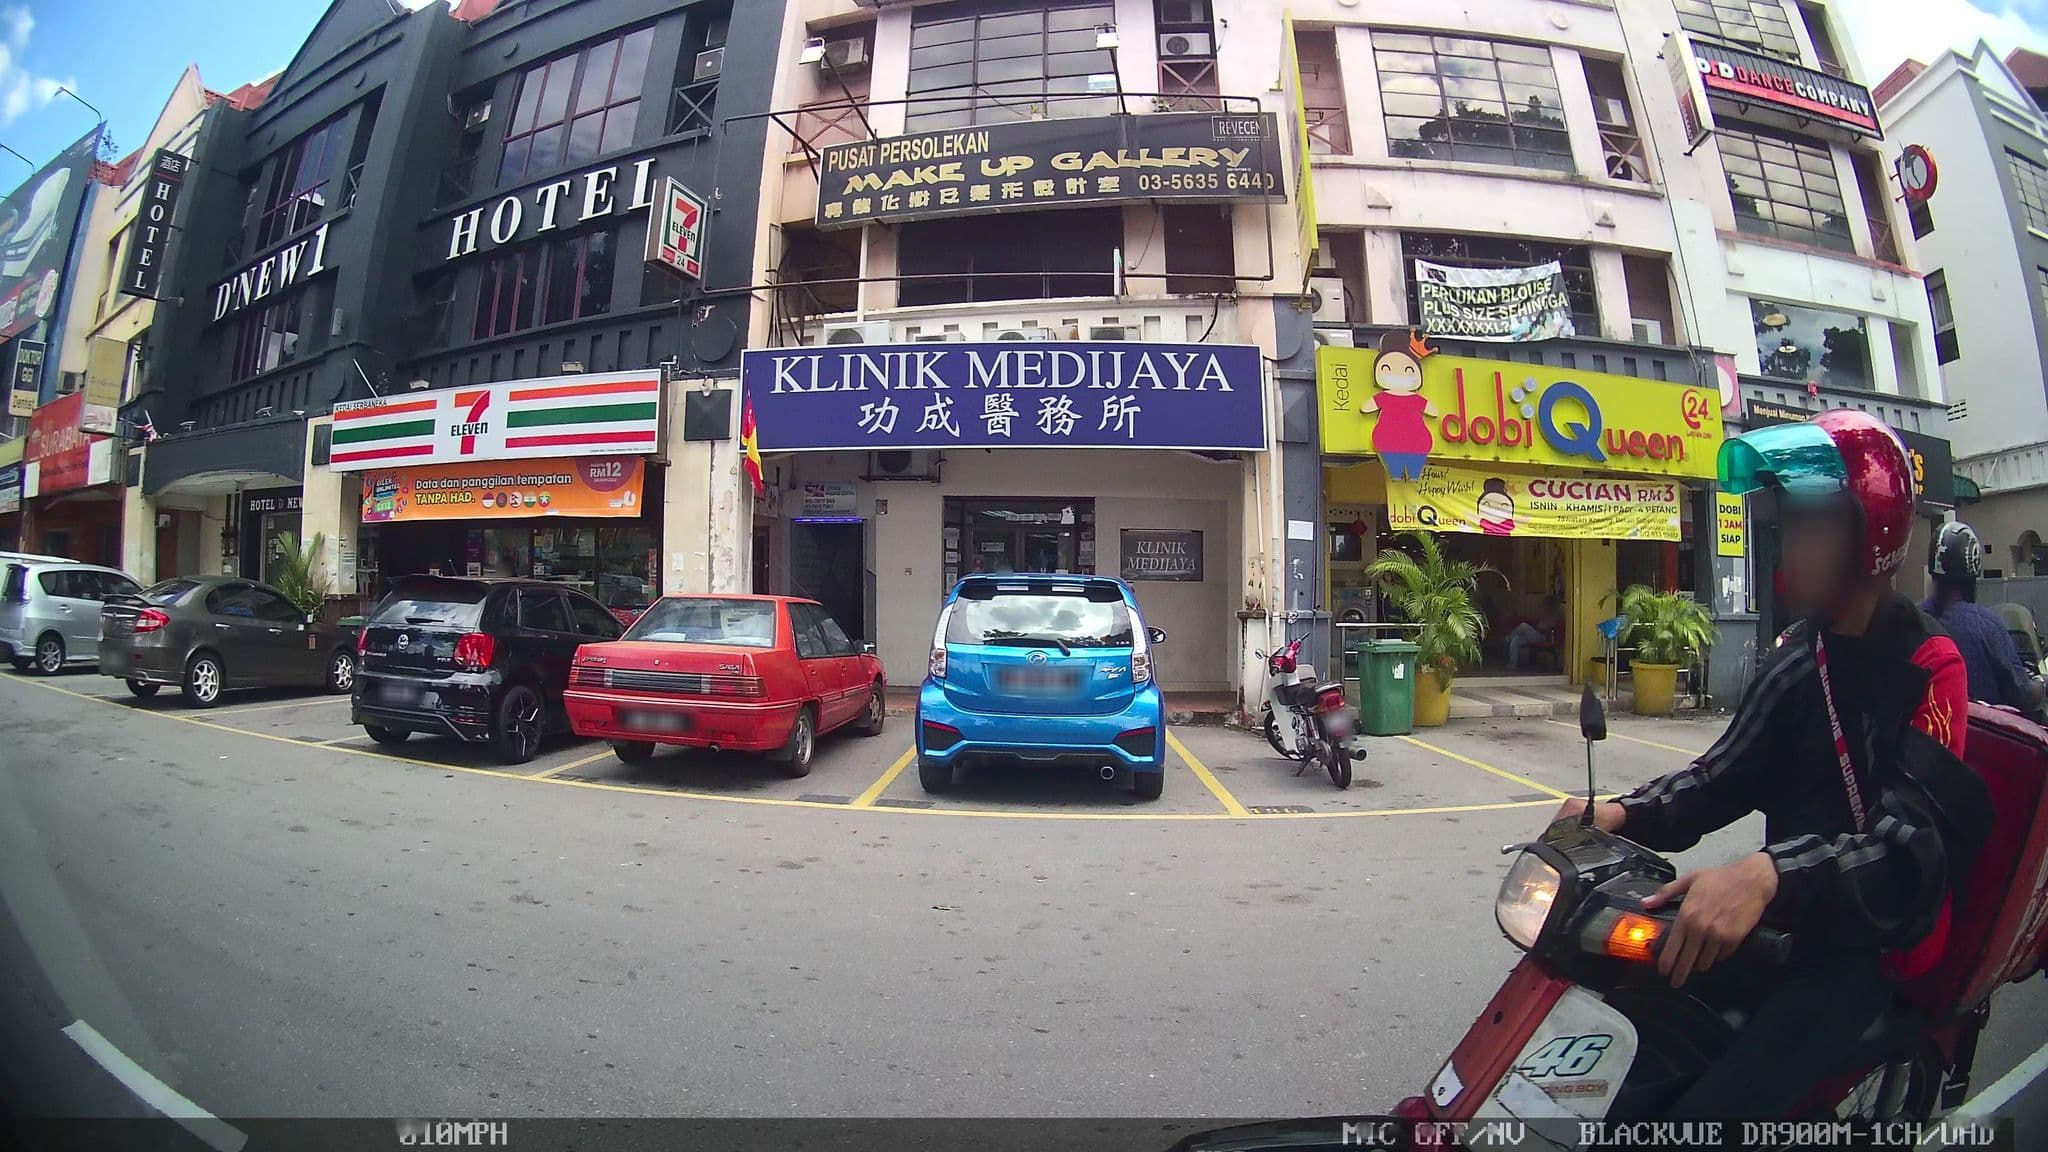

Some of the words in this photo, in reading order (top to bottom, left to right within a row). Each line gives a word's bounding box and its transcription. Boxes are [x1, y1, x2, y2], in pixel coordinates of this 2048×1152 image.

[1736, 66, 1794, 94] DANCE
[1795, 82, 1869, 117] COMPANY
[828, 145, 877, 173] PUSAT
[880, 131, 989, 165] PERSOLEKAN
[842, 162, 965, 195] MAKE
[980, 156, 1034, 177] UP
[1050, 147, 1249, 172] GALLERY
[1138, 173, 1219, 190] 03-5635
[446, 158, 655, 260] HOTEL
[134, 182, 171, 289] HOTEL
[1501, 278, 1552, 303] BLOUSE
[1424, 300, 1459, 318] PLUS
[1463, 305, 1496, 321] SIZE
[770, 351, 950, 394] KLINIK
[964, 350, 1234, 392] MEDIJAYA
[1331, 363, 1350, 411] Kedai
[858, 392, 1141, 438] 功成醫務所
[1688, 397, 1708, 419] 24
[416, 480, 438, 489] Data
[440, 479, 459, 488] dan
[462, 475, 514, 489] panggilan
[517, 475, 572, 486] tempatan
[1528, 479, 1631, 502] CUCIAN
[251, 499, 275, 510] HOTEL
[416, 493, 447, 505] TANPA
[450, 492, 475, 503] HAD.
[1530, 501, 1557, 511] ISNIN
[1720, 505, 1741, 515] DOBI
[1724, 519, 1743, 529] JAM
[1136, 541, 1187, 555] KLINIK
[1721, 534, 1741, 544] SIAP
[1127, 557, 1196, 573] MEDIJAYA
[1518, 1034, 1613, 1077] 46
[1575, 1083, 1604, 1094] BOY
